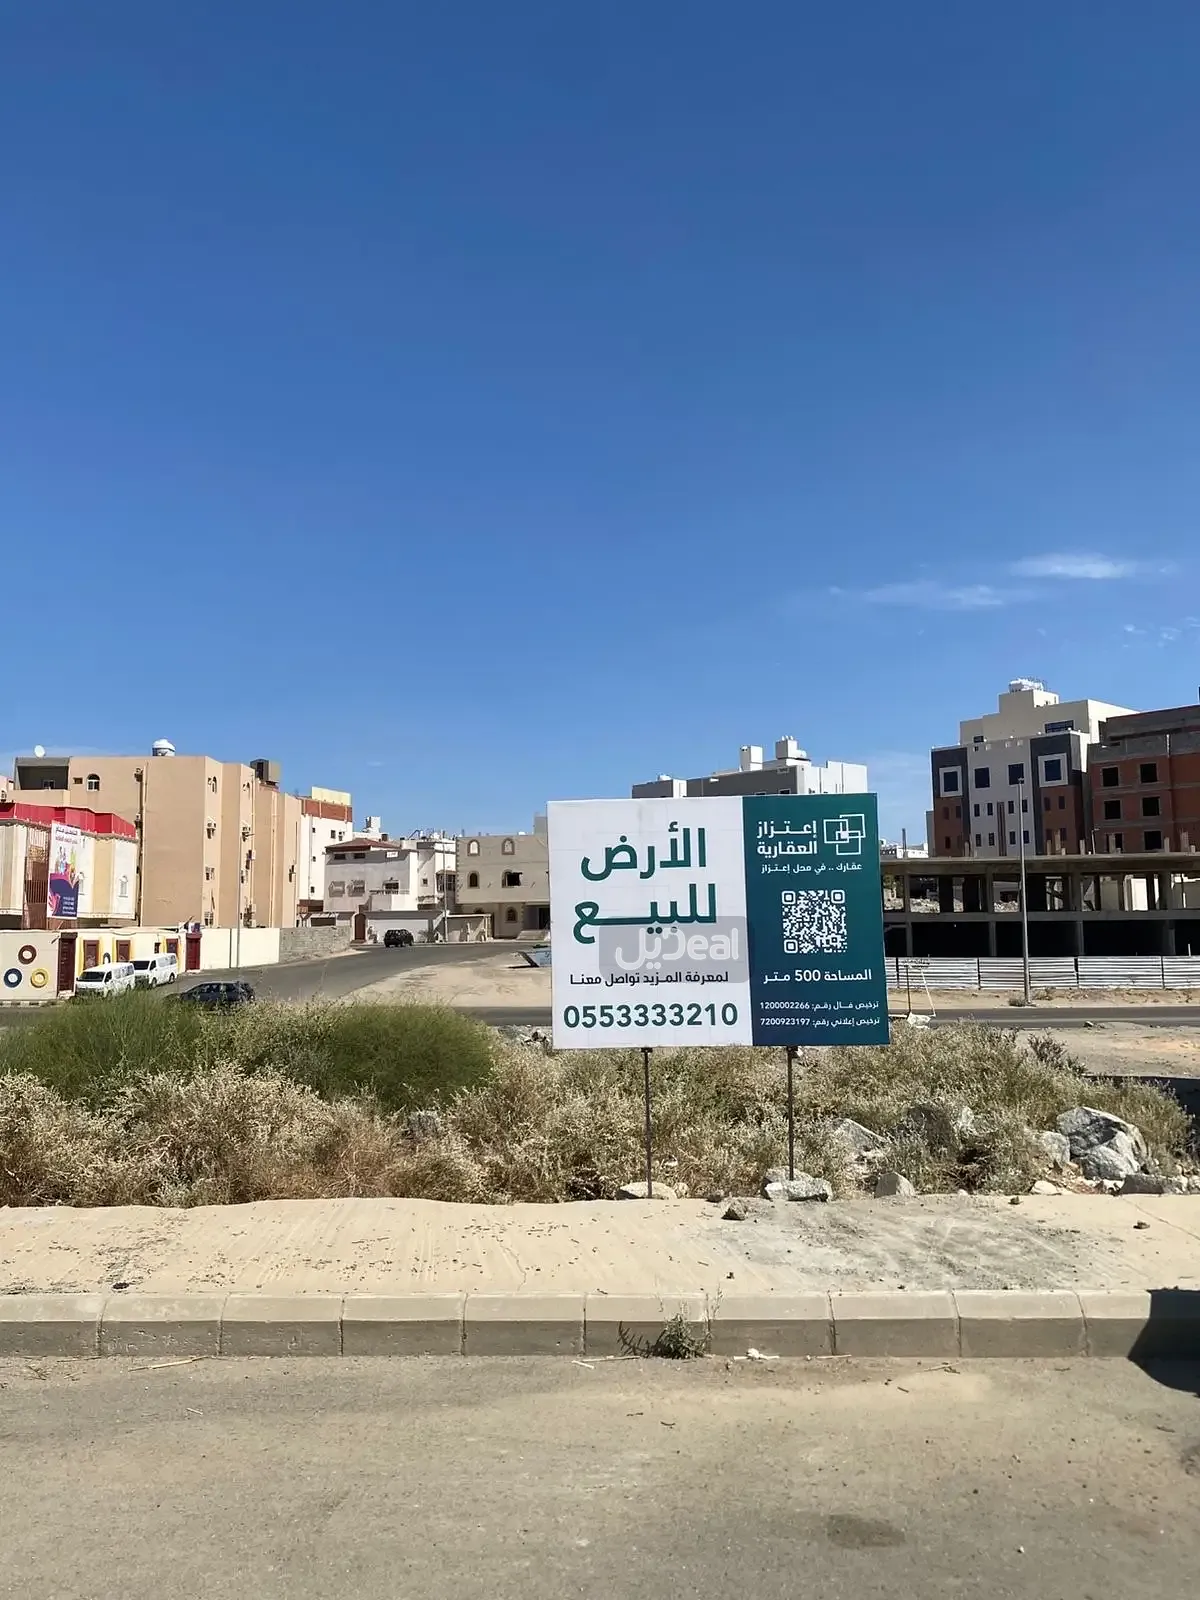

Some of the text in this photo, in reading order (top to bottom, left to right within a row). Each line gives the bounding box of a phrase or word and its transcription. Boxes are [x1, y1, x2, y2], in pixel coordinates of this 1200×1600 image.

[757, 820, 817, 839] إعتزاز
[581, 821, 706, 881] الأرض
[757, 840, 818, 859] العقارية
[793, 864, 812, 874] محل
[814, 862, 826, 875] في
[836, 862, 863, 873] عقارك
[573, 883, 717, 944] للبيع
[570, 971, 729, 987] لمعرفة المزيد تواصل معنا
[763, 968, 872, 984] المساحة 500 متر
[760, 1001, 810, 1010] 1200002266
[833, 1001, 854, 1011] فال
[855, 1001, 879, 1010] ترخيص
[563, 1002, 738, 1029] 0553333210
[760, 1017, 810, 1026] 7200923197
[856, 1016, 880, 1026] ترخيص
[831, 1017, 855, 1028] إعلاني
